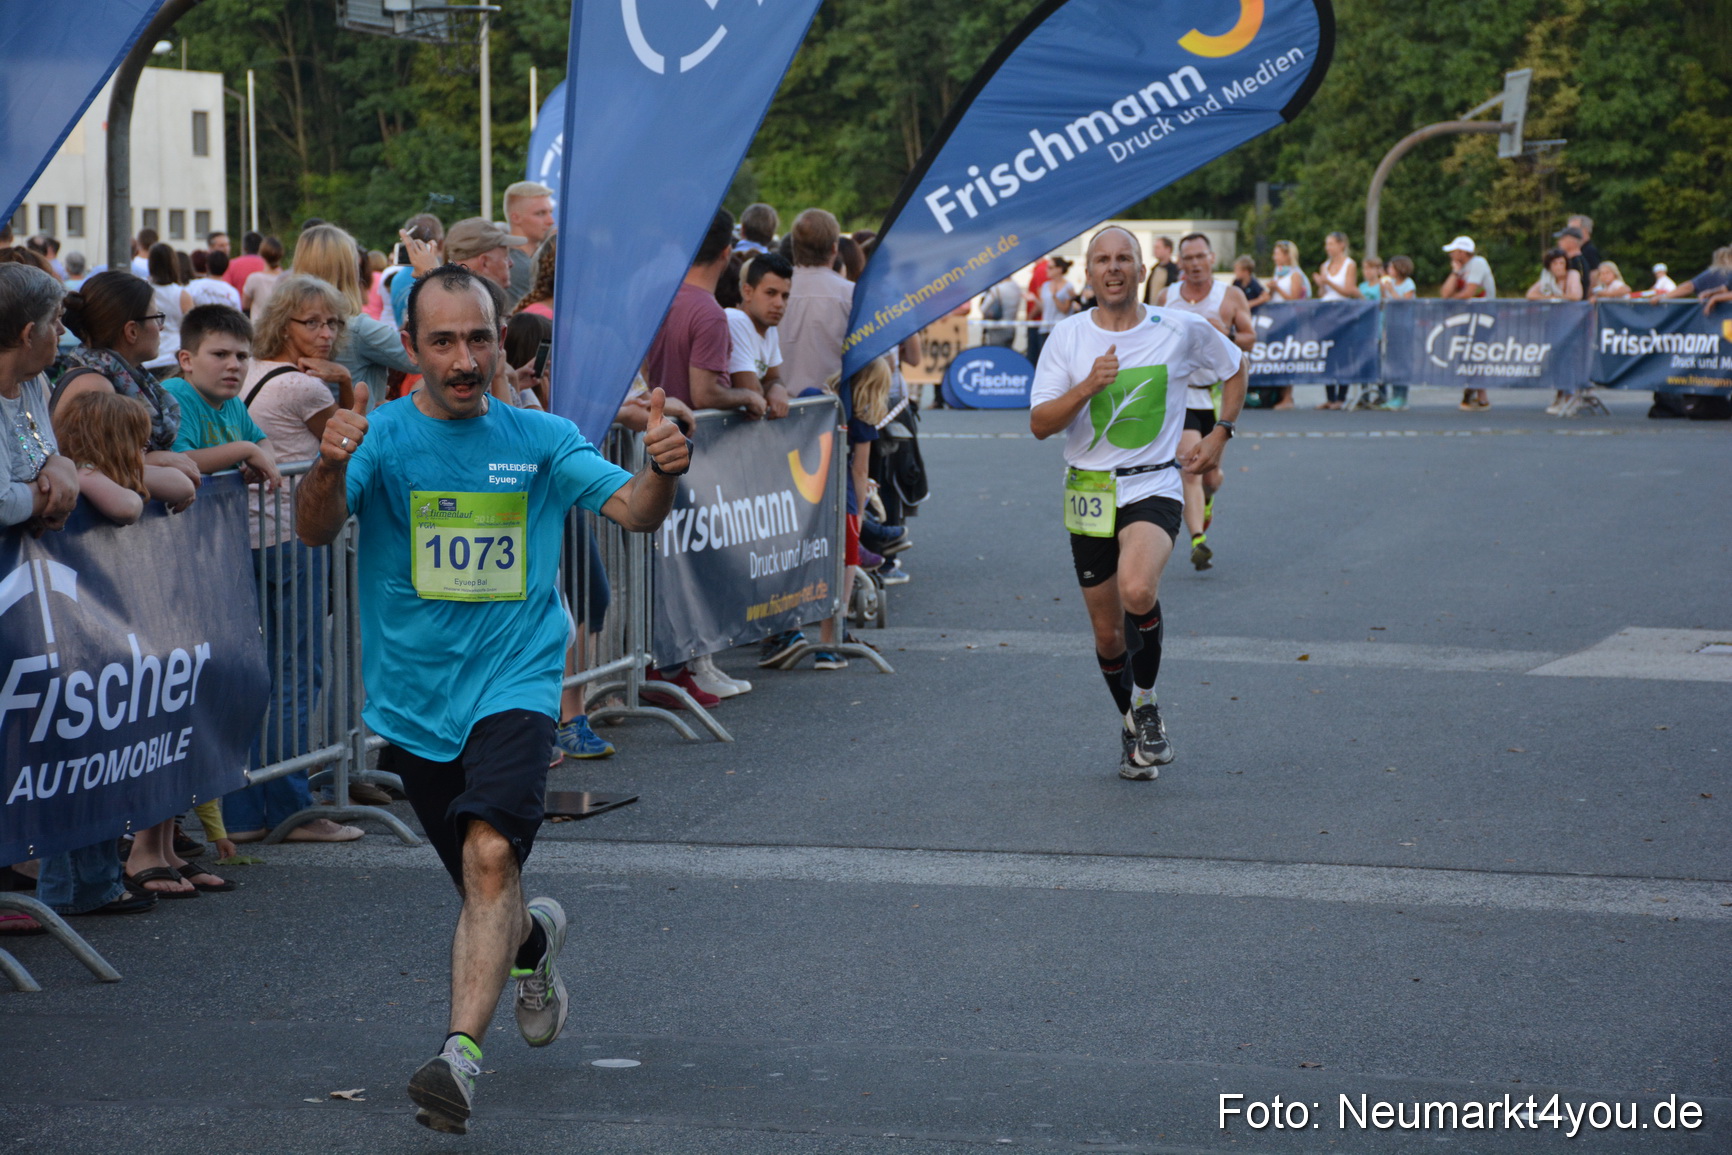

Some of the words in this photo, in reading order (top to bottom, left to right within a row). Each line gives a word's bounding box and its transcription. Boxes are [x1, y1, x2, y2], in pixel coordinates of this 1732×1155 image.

[1107, 116, 1176, 164] Druck
[1177, 93, 1223, 125] und
[1221, 46, 1305, 104] Medien
[924, 65, 1208, 234] Frischmann
[841, 233, 1020, 355] www.frischmann-net.de
[1248, 334, 1335, 361] scher
[1447, 335, 1552, 363] Fischer
[1600, 327, 1720, 356] Frischmann
[971, 372, 1029, 388] Fischer
[1248, 360, 1327, 375] UTOMOBILE
[1456, 363, 1541, 377] AUTOMOBILE
[489, 475, 517, 485] Eyuep
[1070, 495, 1103, 518] 103
[425, 534, 515, 570] 1073
[749, 545, 780, 580] Druck
[780, 539, 801, 572] und
[454, 578, 476, 586] Eyuep
[477, 578, 488, 586] Bal
[0, 632, 212, 744] Fischer
[5, 726, 194, 806] AUTOMOBILE
